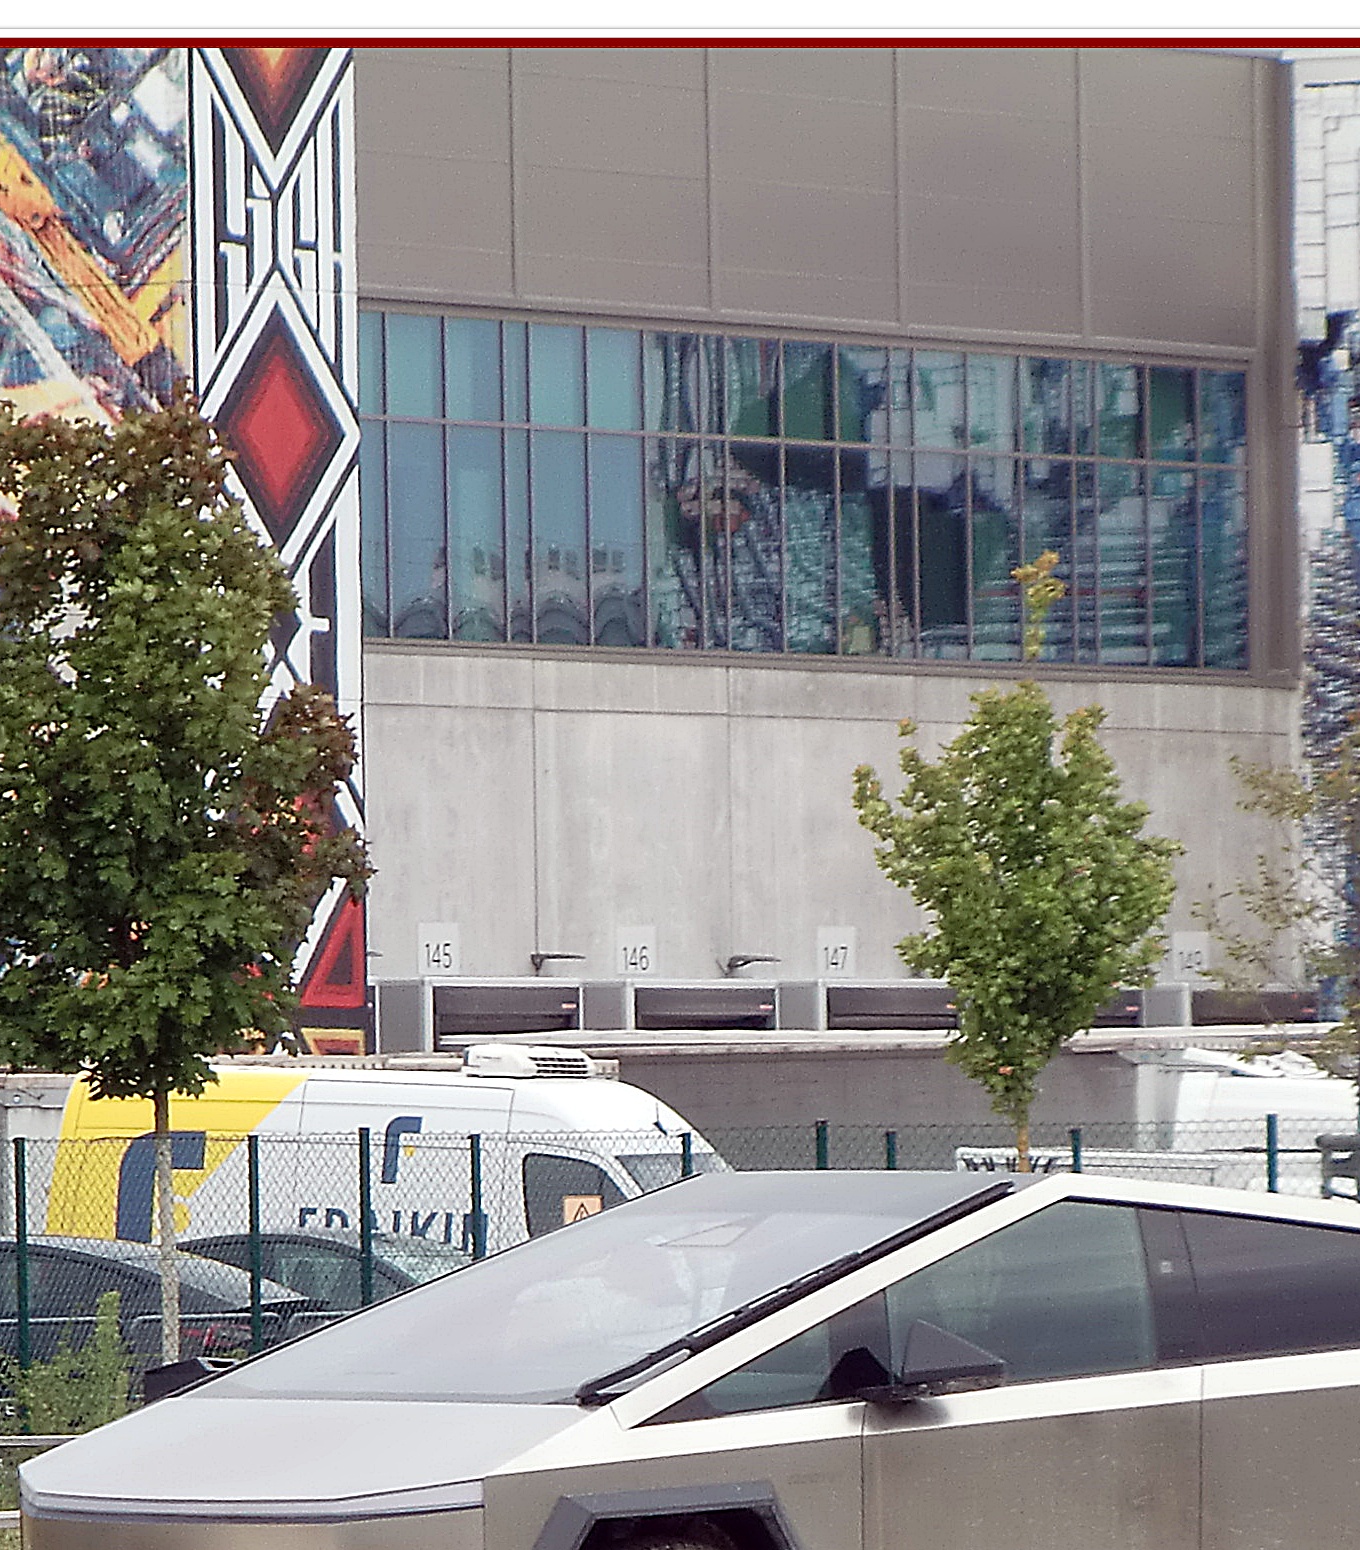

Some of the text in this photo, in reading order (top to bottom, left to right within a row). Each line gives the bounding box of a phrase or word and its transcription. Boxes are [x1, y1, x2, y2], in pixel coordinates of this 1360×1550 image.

[425, 943, 452, 968] 145
[623, 945, 649, 970] 146
[824, 946, 848, 969] 147
